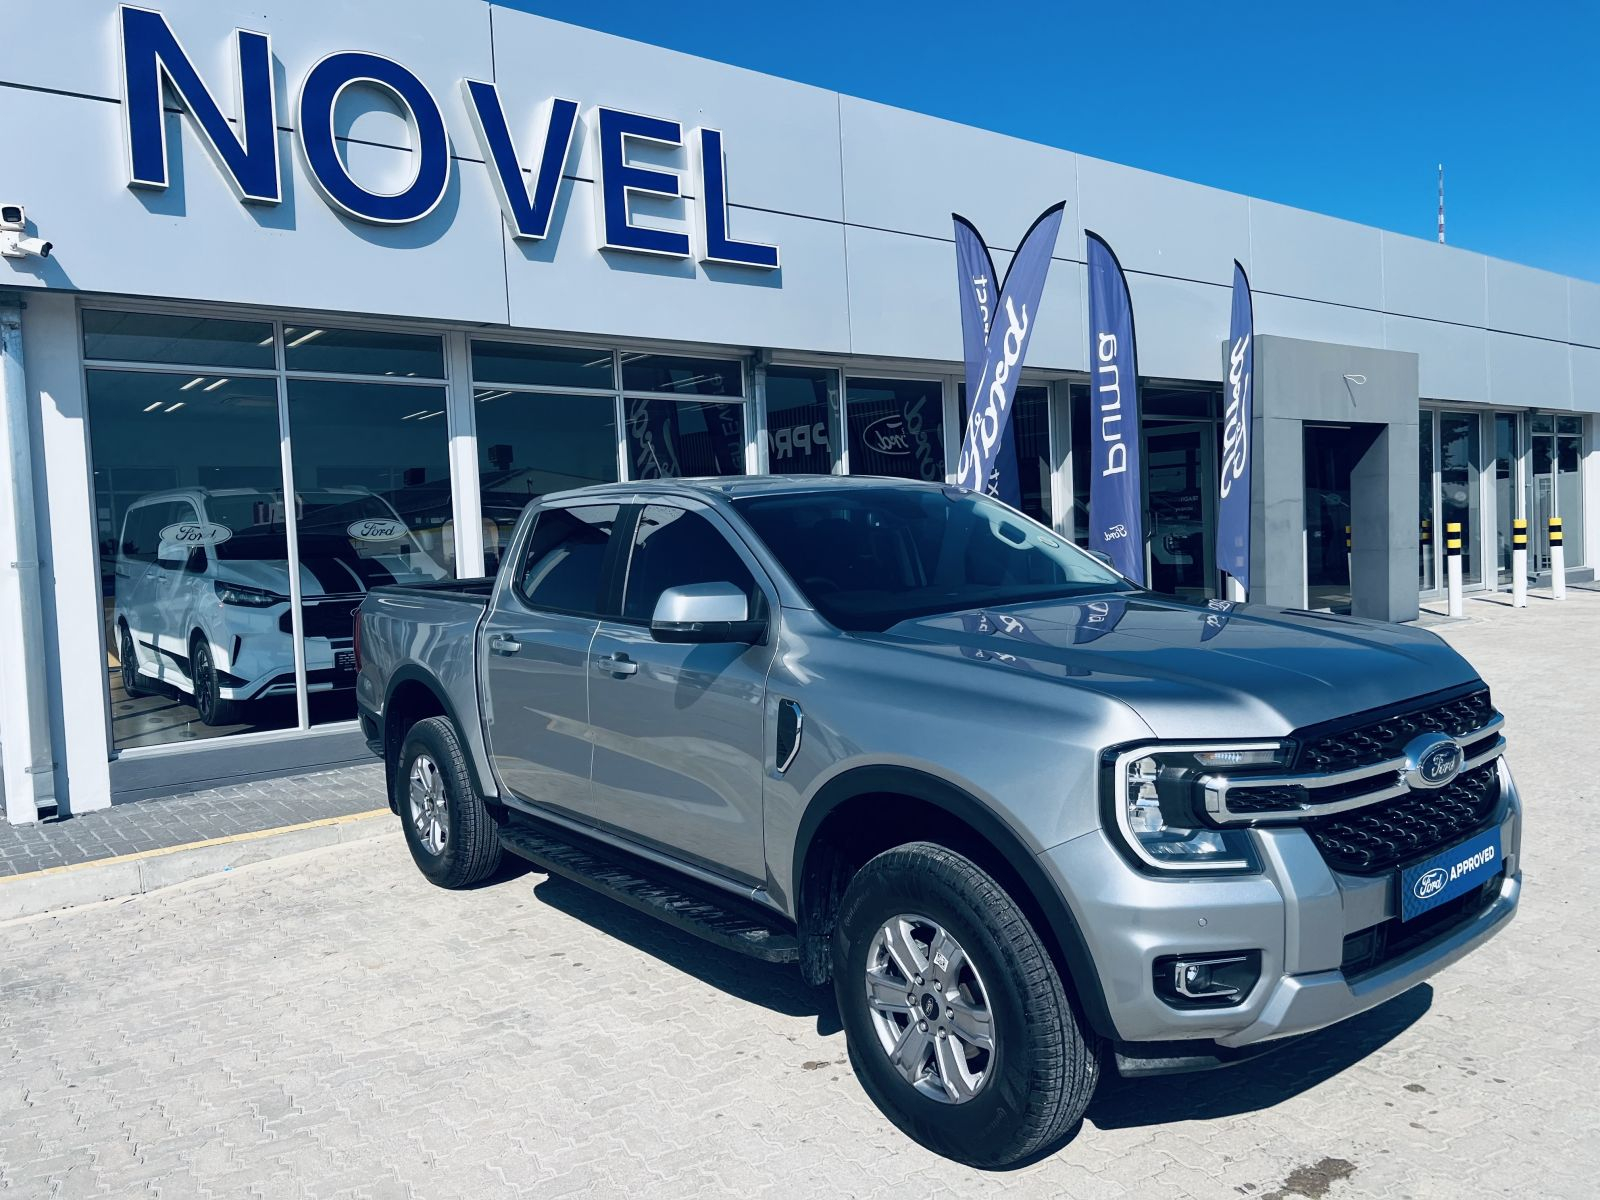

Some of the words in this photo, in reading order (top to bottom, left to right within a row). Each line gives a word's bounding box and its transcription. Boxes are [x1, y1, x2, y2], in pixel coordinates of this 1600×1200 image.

[119, 3, 780, 271] NOVEL
[957, 296, 1028, 492] Ford
[361, 522, 395, 536] Ford
[1431, 752, 1456, 777] Ford
[1419, 872, 1443, 896] Ford
[1449, 845, 1495, 881] APPROVED
